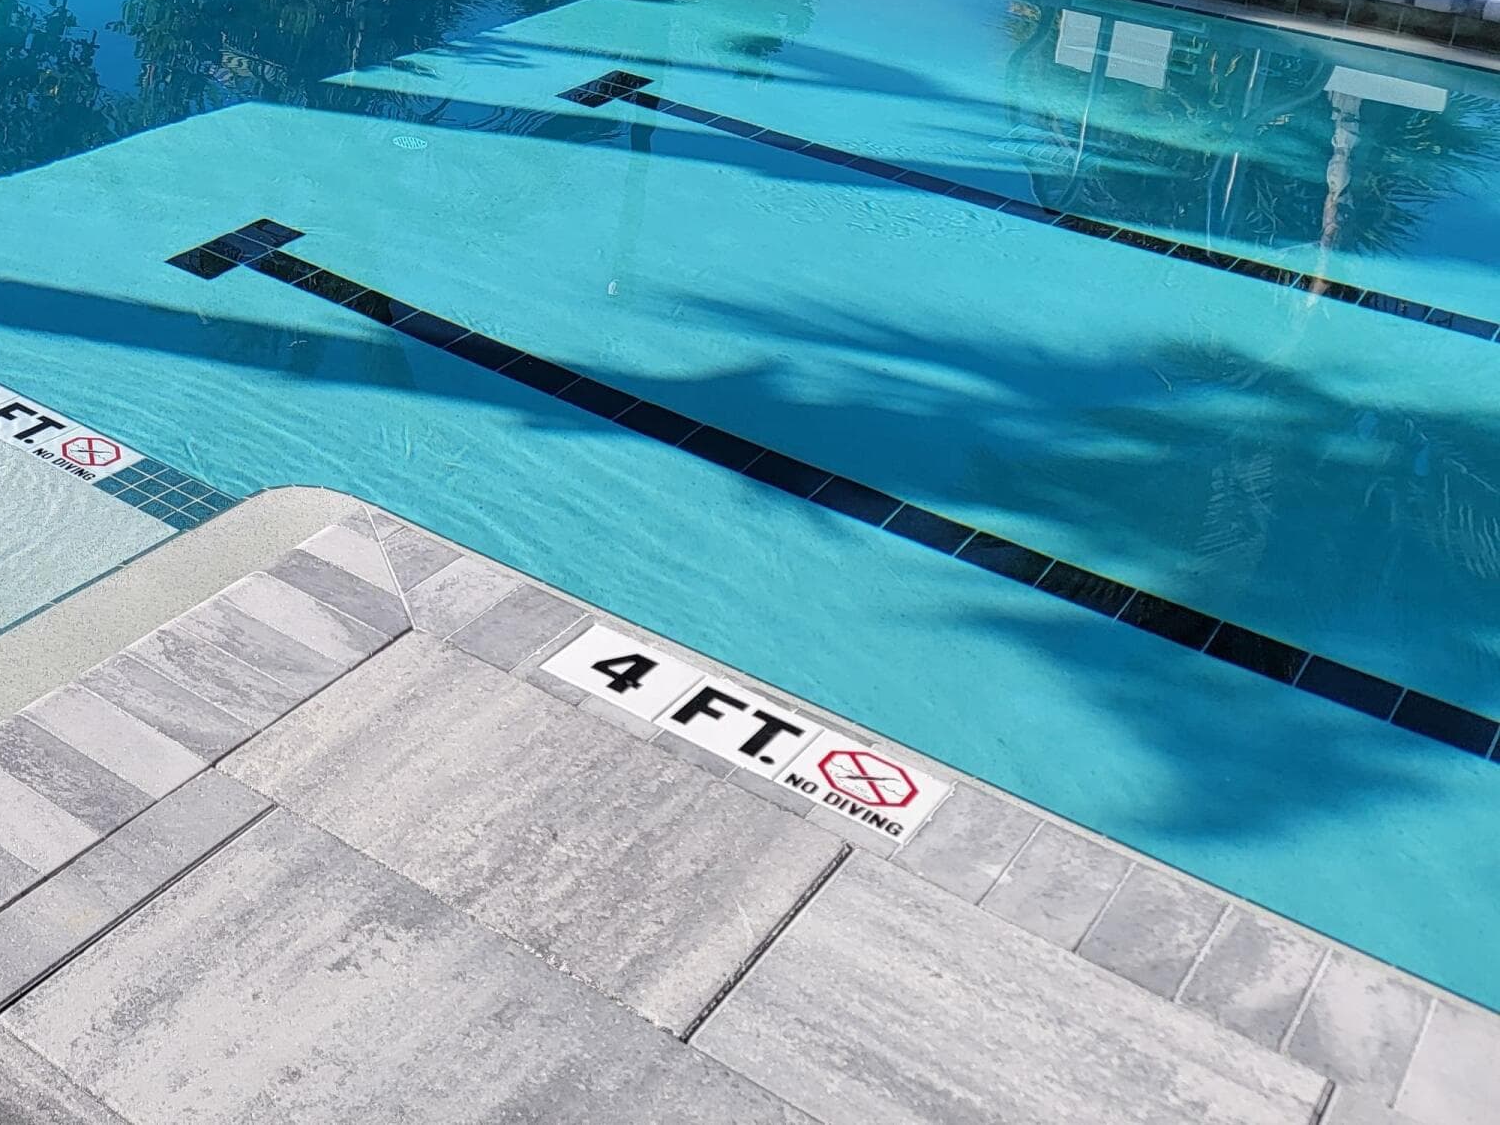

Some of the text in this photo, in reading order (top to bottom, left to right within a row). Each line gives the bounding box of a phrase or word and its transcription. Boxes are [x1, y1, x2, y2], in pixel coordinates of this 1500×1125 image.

[32, 448, 96, 481] NO DIVING
[591, 653, 805, 765] 4 FT.
[785, 773, 819, 795] NO
[823, 791, 905, 837] DIVING
